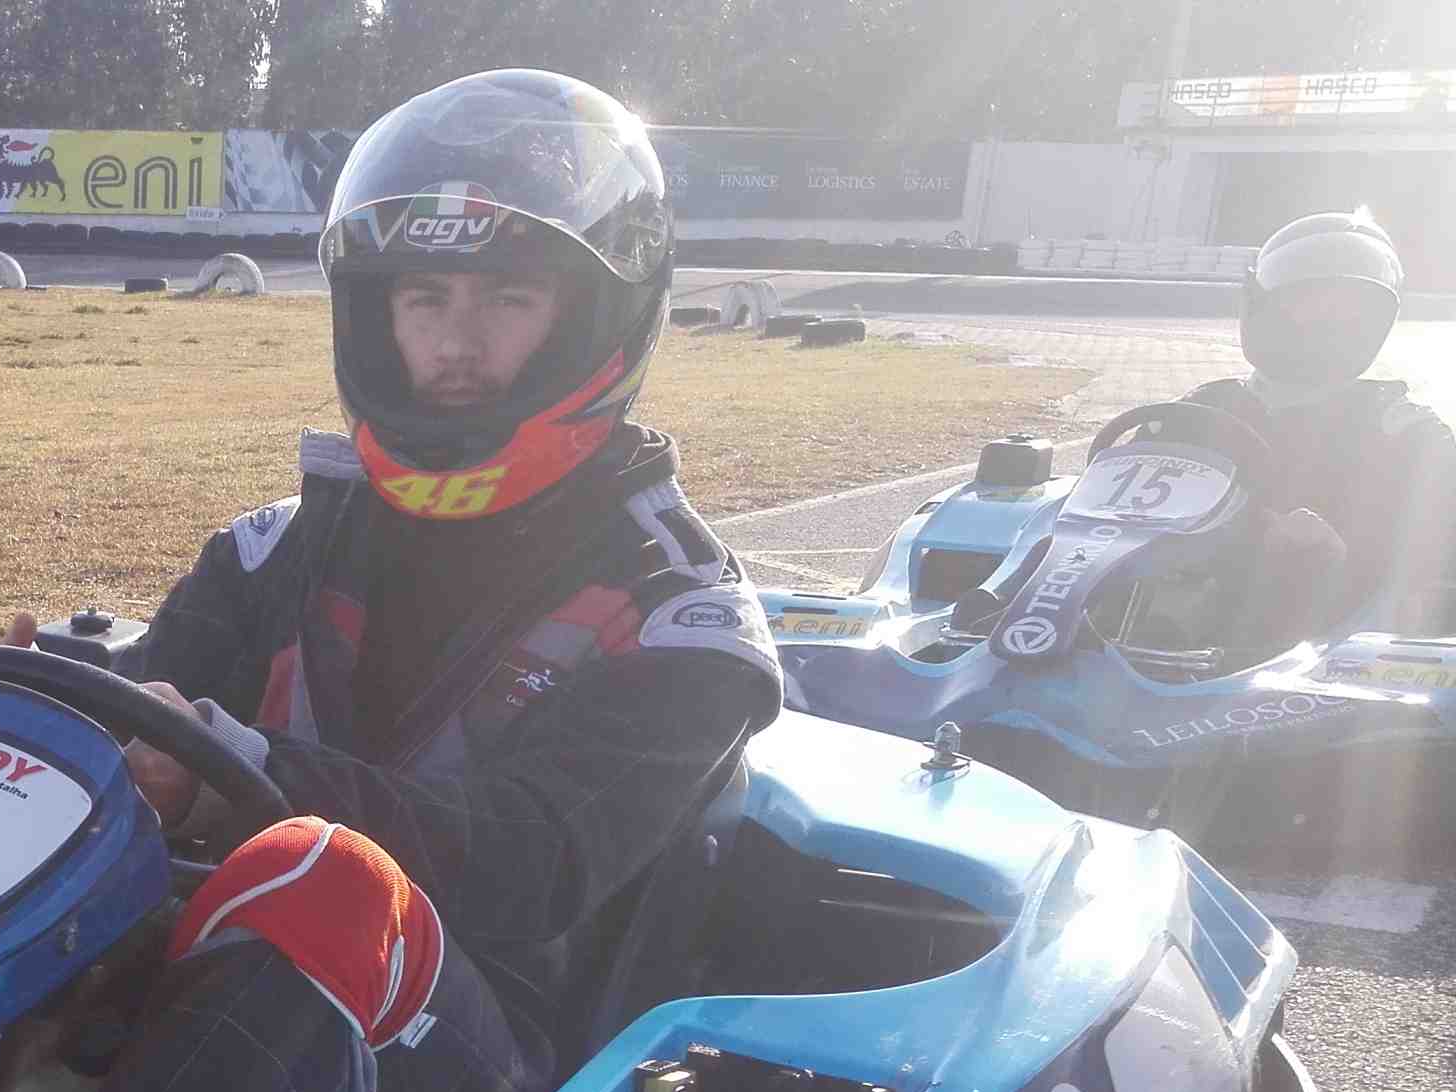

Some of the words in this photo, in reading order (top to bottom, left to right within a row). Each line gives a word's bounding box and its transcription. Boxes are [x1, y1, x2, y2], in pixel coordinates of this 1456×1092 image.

[1305, 77, 1377, 96] HASCO
[84, 136, 205, 211] eni
[719, 175, 780, 188] FINANCE
[807, 175, 877, 191] LOGISTICS
[407, 216, 492, 244] agv
[379, 465, 507, 515] 46
[1107, 463, 1185, 511] 15
